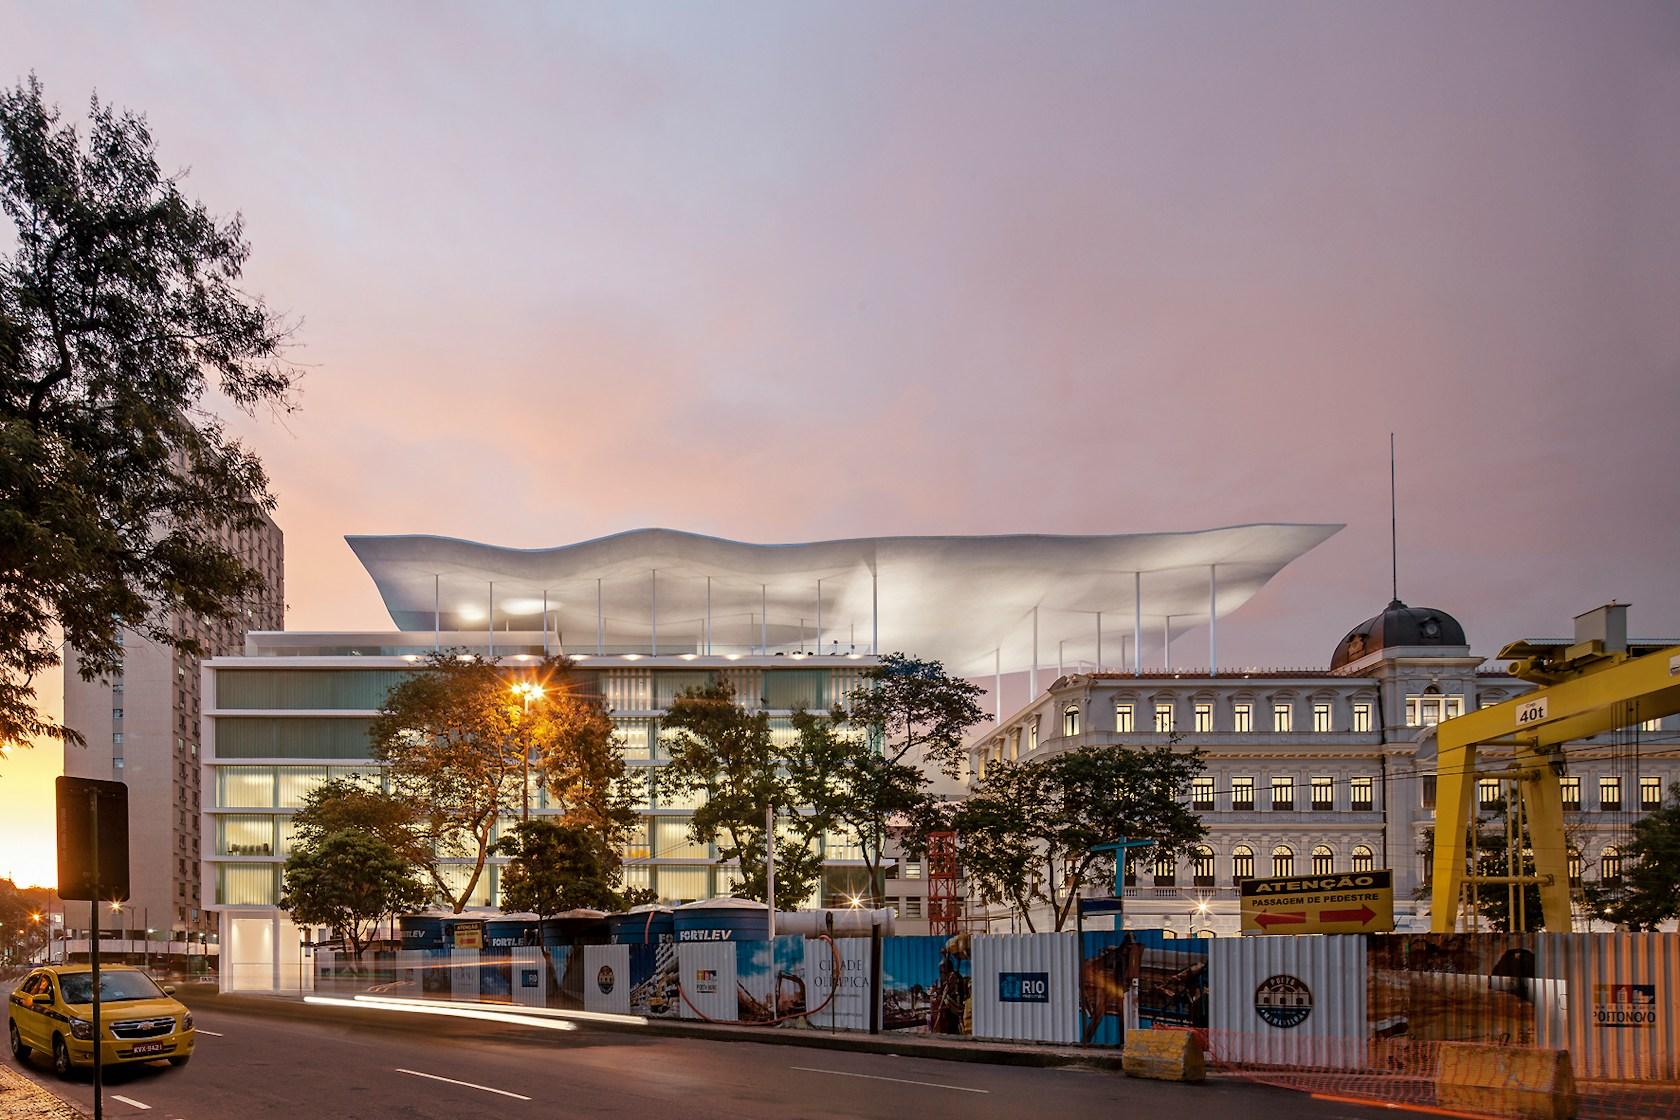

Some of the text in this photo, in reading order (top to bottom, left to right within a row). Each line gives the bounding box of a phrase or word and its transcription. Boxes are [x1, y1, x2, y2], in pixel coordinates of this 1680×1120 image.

[1520, 706, 1544, 722] 40t
[1256, 876, 1374, 893] ATENÇÃO
[1252, 893, 1379, 907] PASSAGEM DE PEDESTRE
[680, 930, 732, 940] FORTLEV
[819, 960, 863, 971] CIADE
[1022, 980, 1045, 994] RIO
